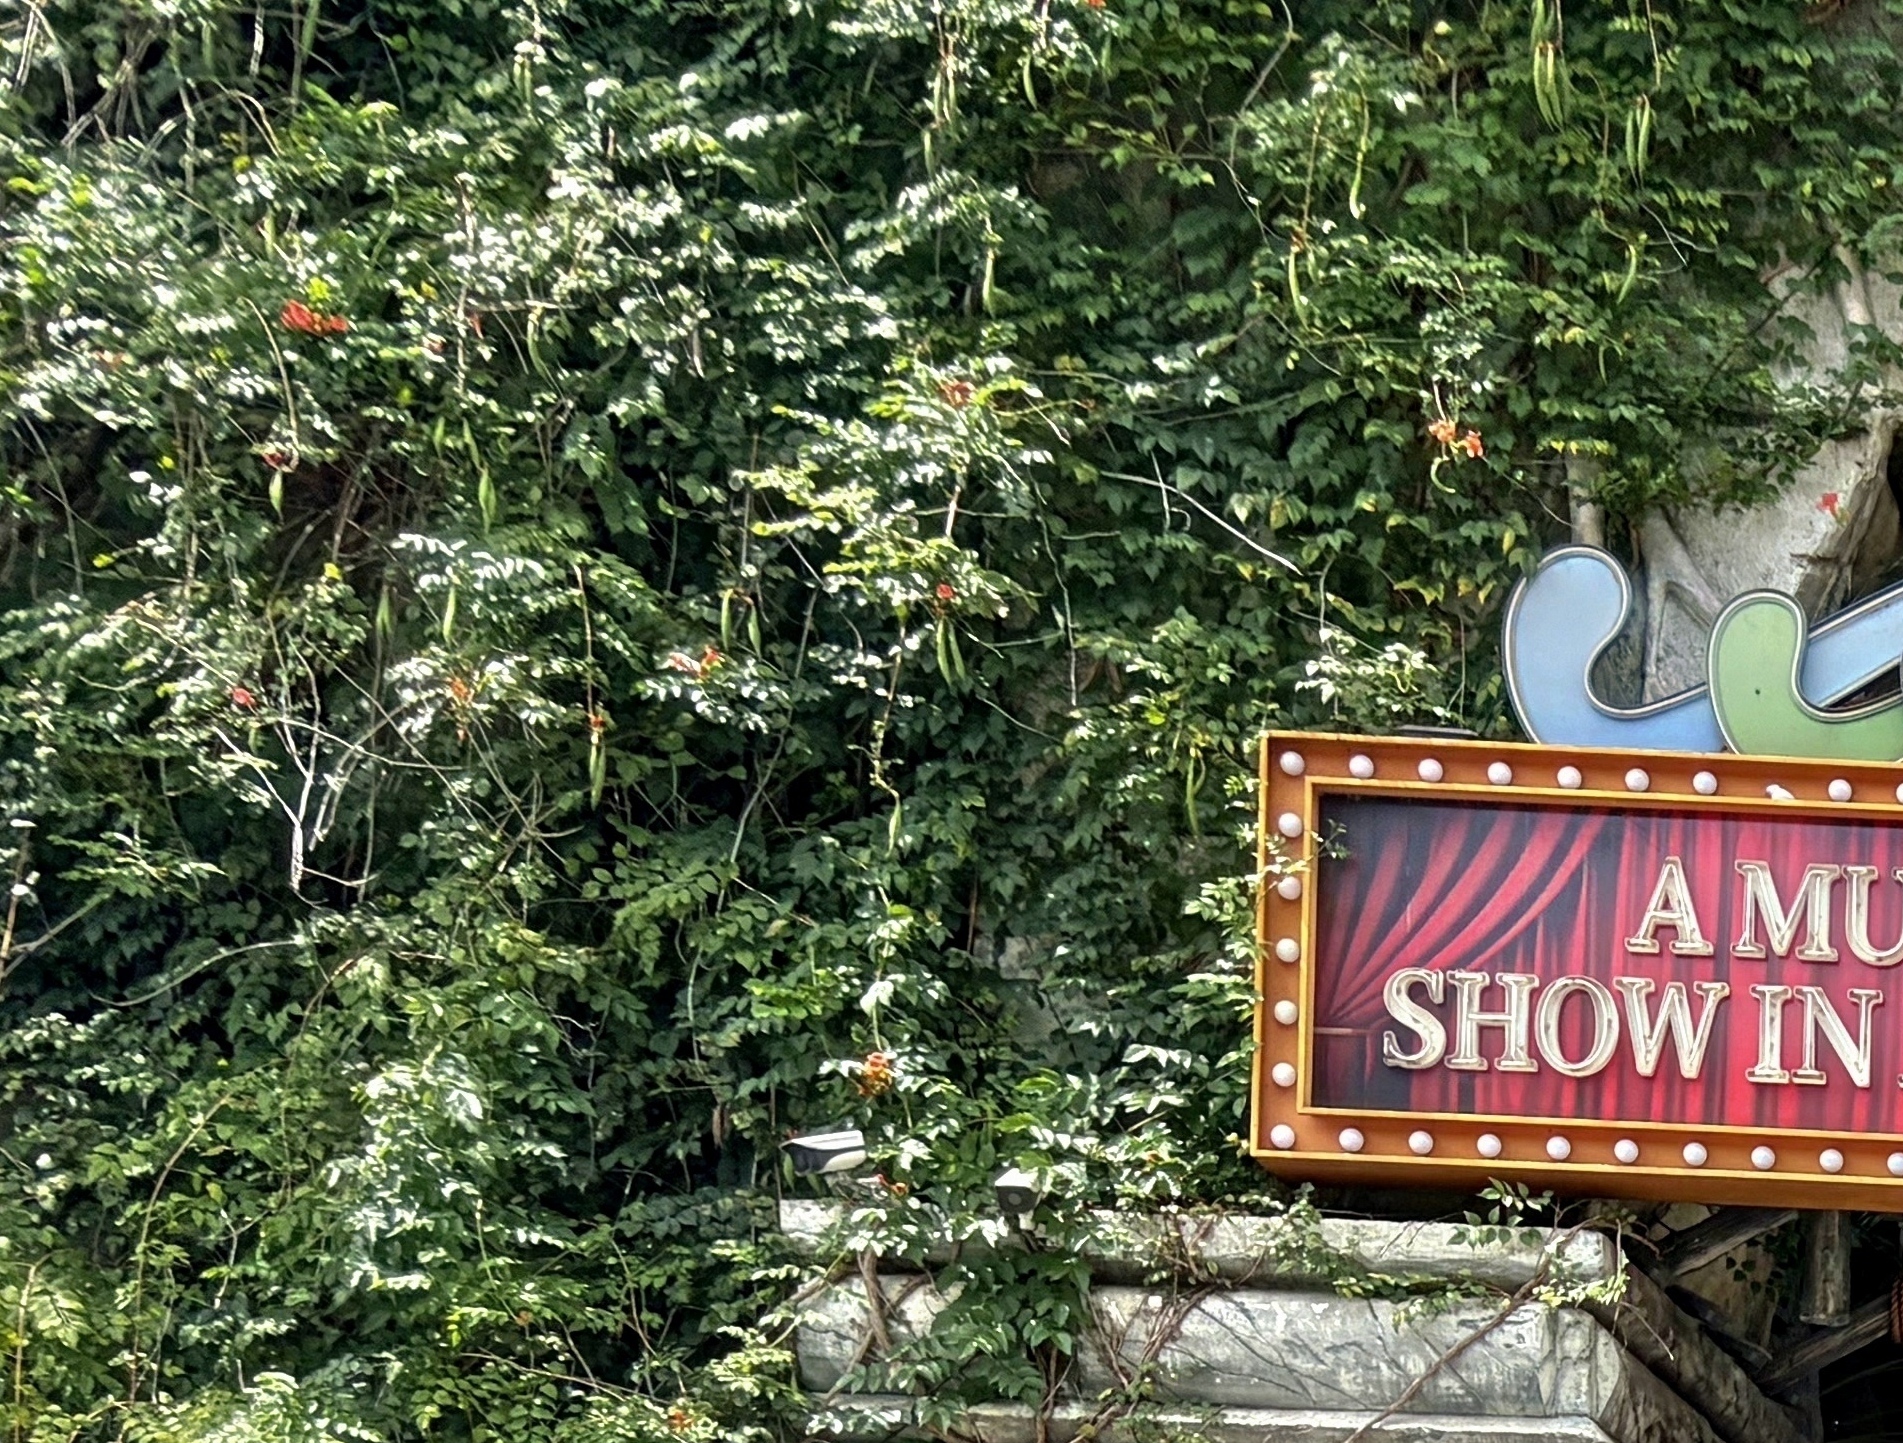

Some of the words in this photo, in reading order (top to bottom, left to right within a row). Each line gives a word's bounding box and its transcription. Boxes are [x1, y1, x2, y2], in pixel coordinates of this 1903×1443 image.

[1624, 853, 1716, 957] A
[1381, 966, 1730, 1078] SHOW
[1745, 984, 1885, 1090] IN
